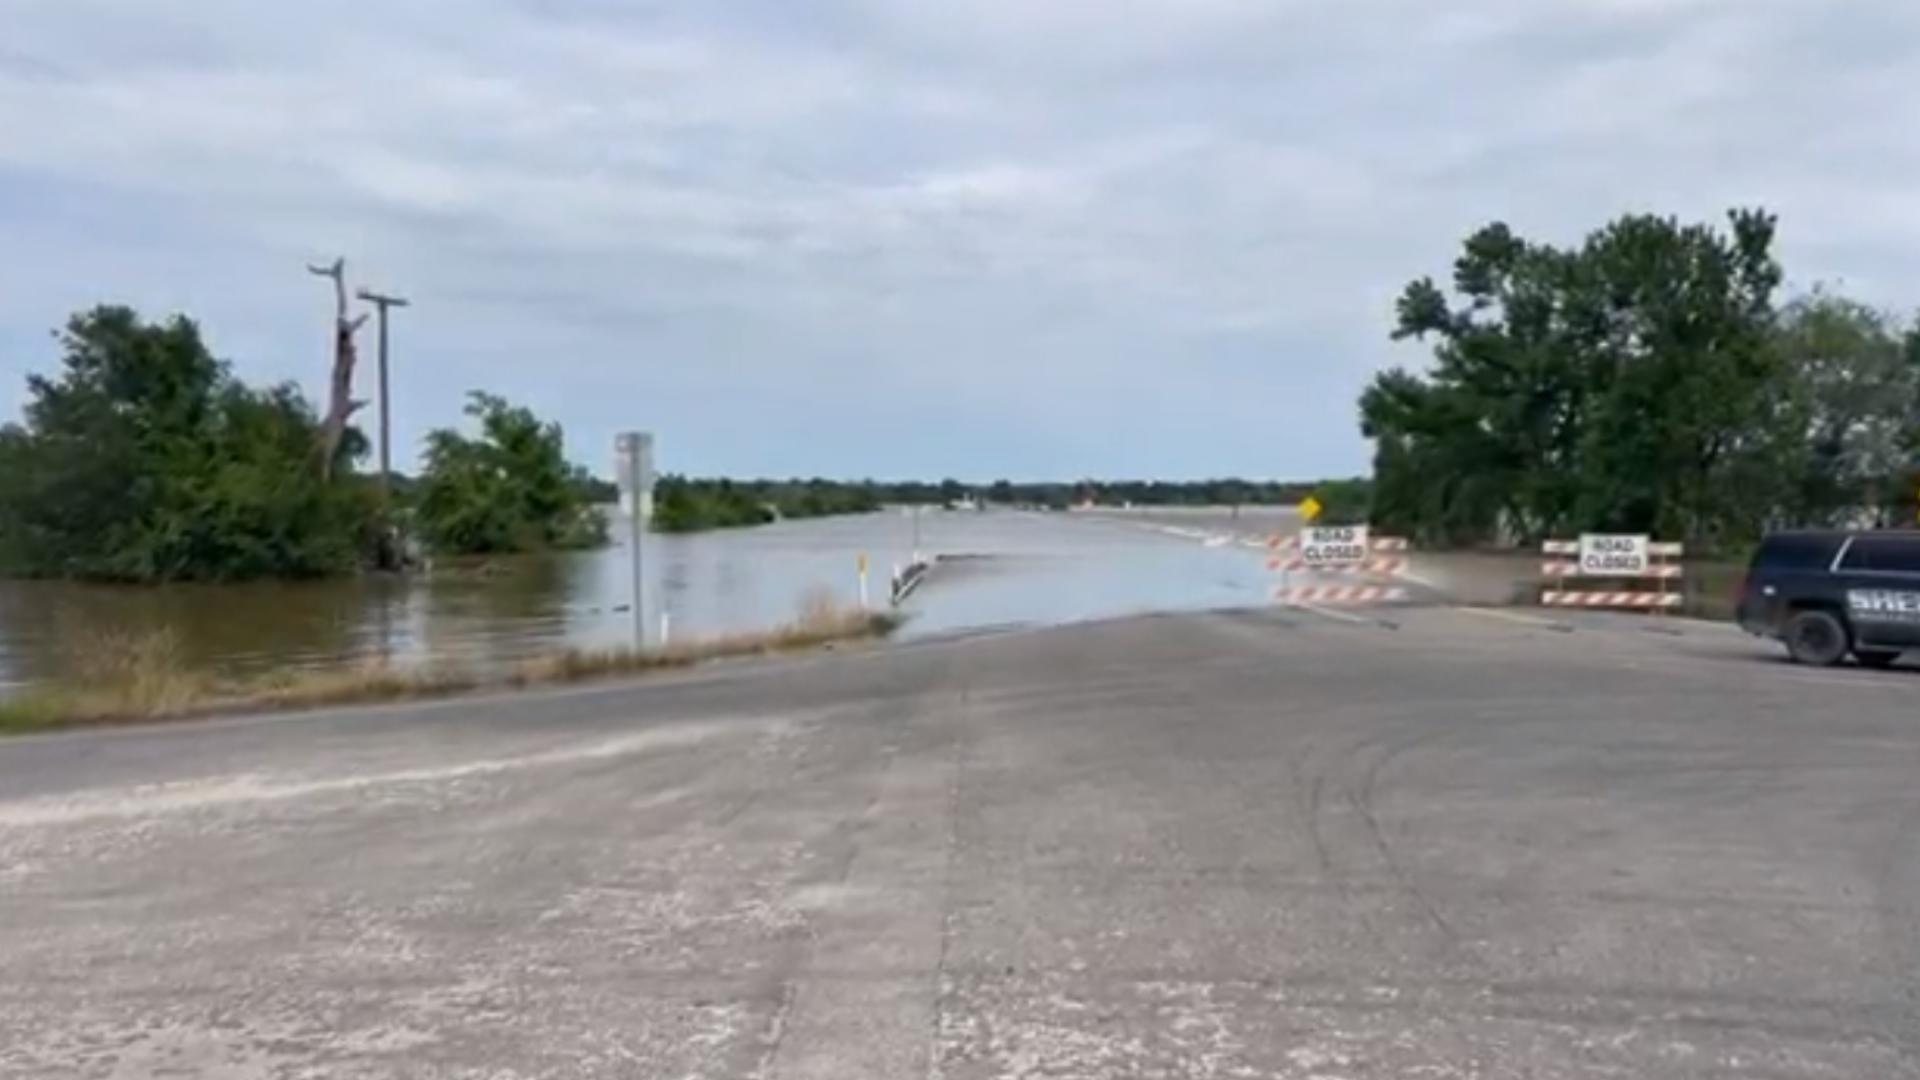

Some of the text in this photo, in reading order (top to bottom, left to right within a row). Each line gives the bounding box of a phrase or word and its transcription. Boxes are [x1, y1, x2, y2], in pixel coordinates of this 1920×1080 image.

[1312, 527, 1356, 543] ROAD
[1305, 545, 1363, 560] CLOSED
[1593, 538, 1635, 552] ROAD
[1585, 553, 1641, 570] CLOSED
[1847, 589, 1920, 611] SHE
